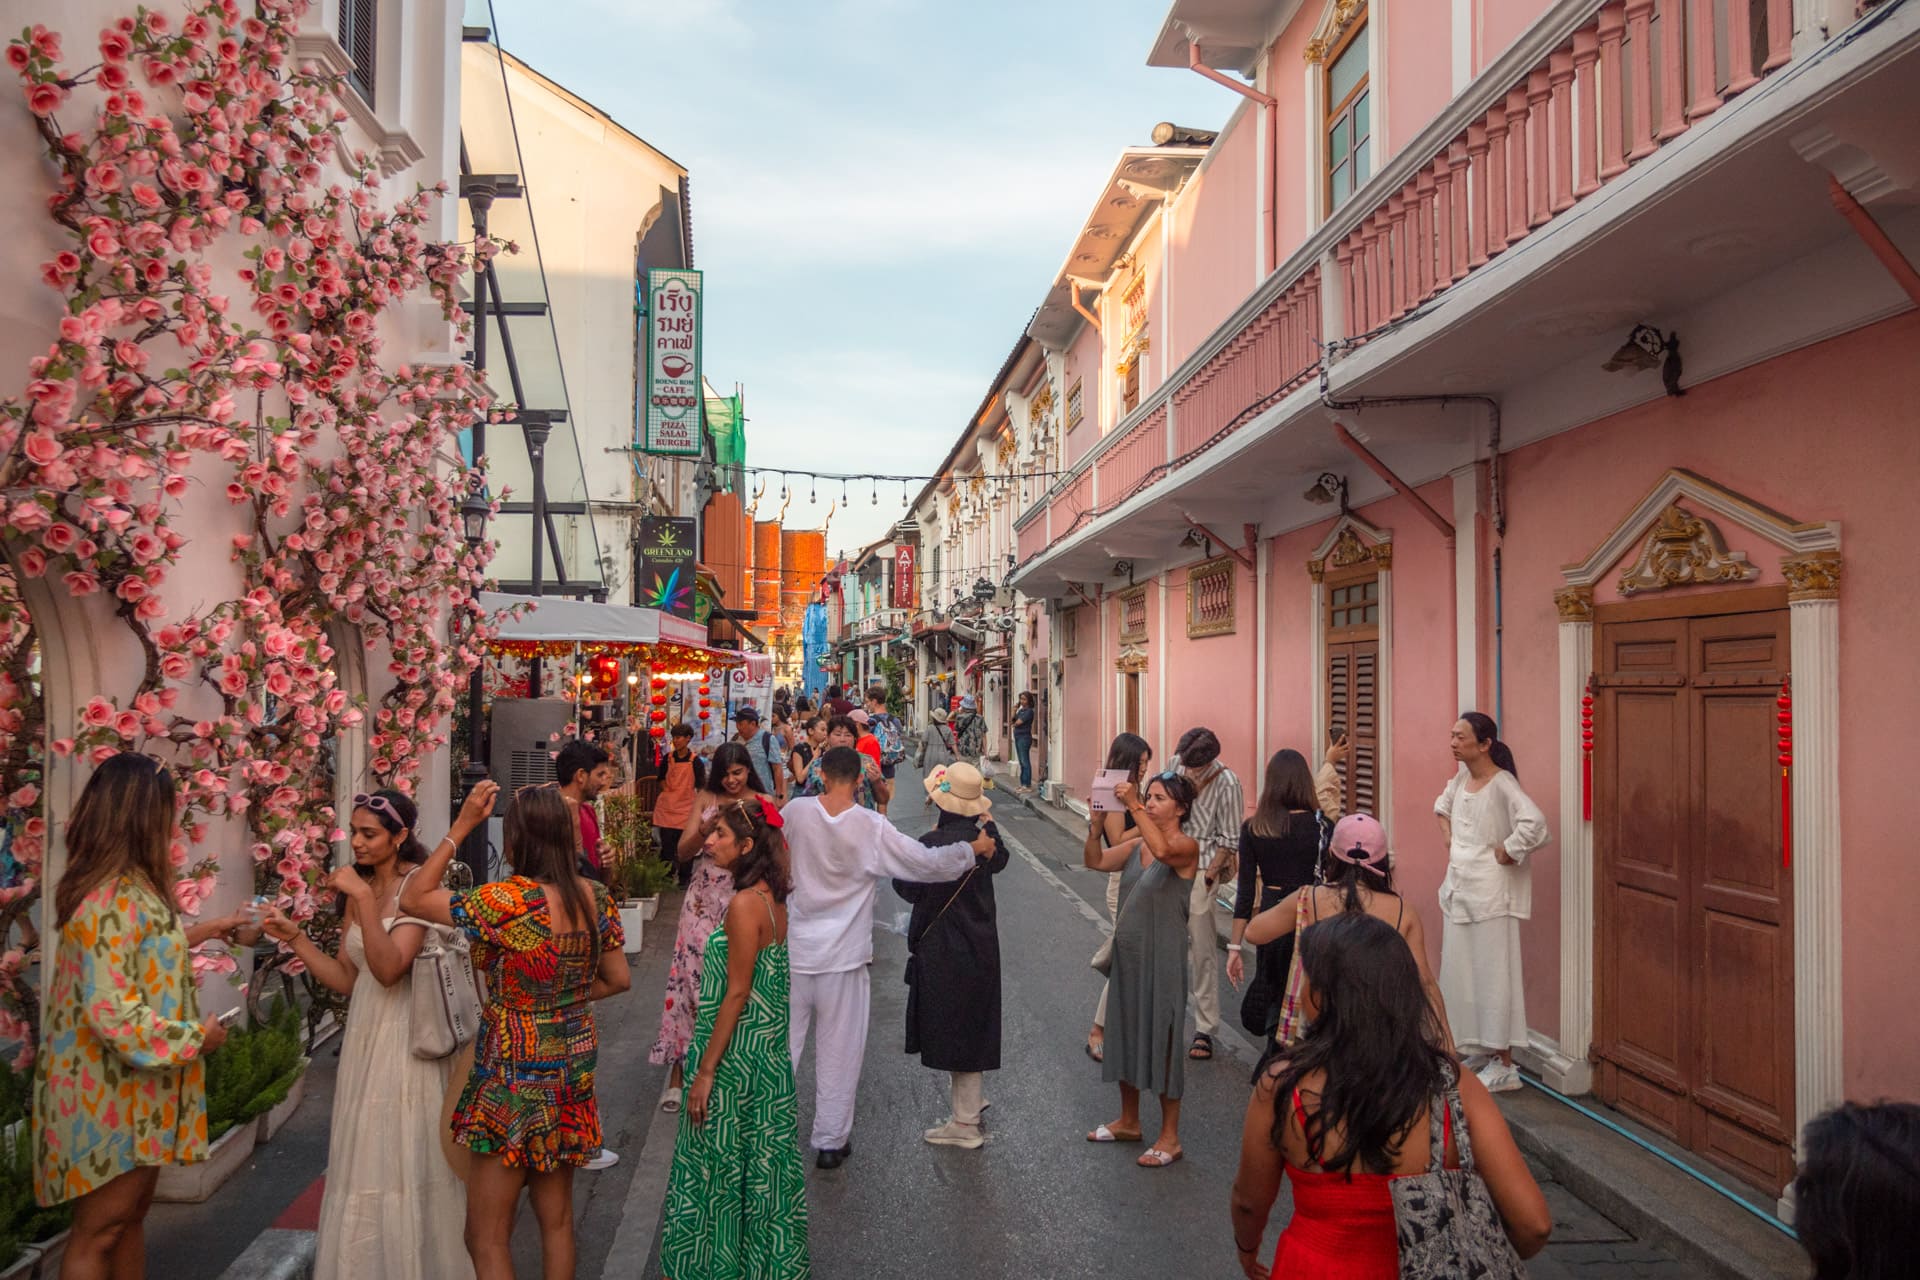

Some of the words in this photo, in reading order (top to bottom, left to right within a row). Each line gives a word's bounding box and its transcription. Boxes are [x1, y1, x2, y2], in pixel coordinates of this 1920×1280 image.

[663, 386, 687, 394] CAFE
[661, 421, 687, 430] PIZZA
[660, 430, 688, 438] SALAD
[656, 438, 691, 447] BURGER
[643, 547, 693, 557] GREENLAND
